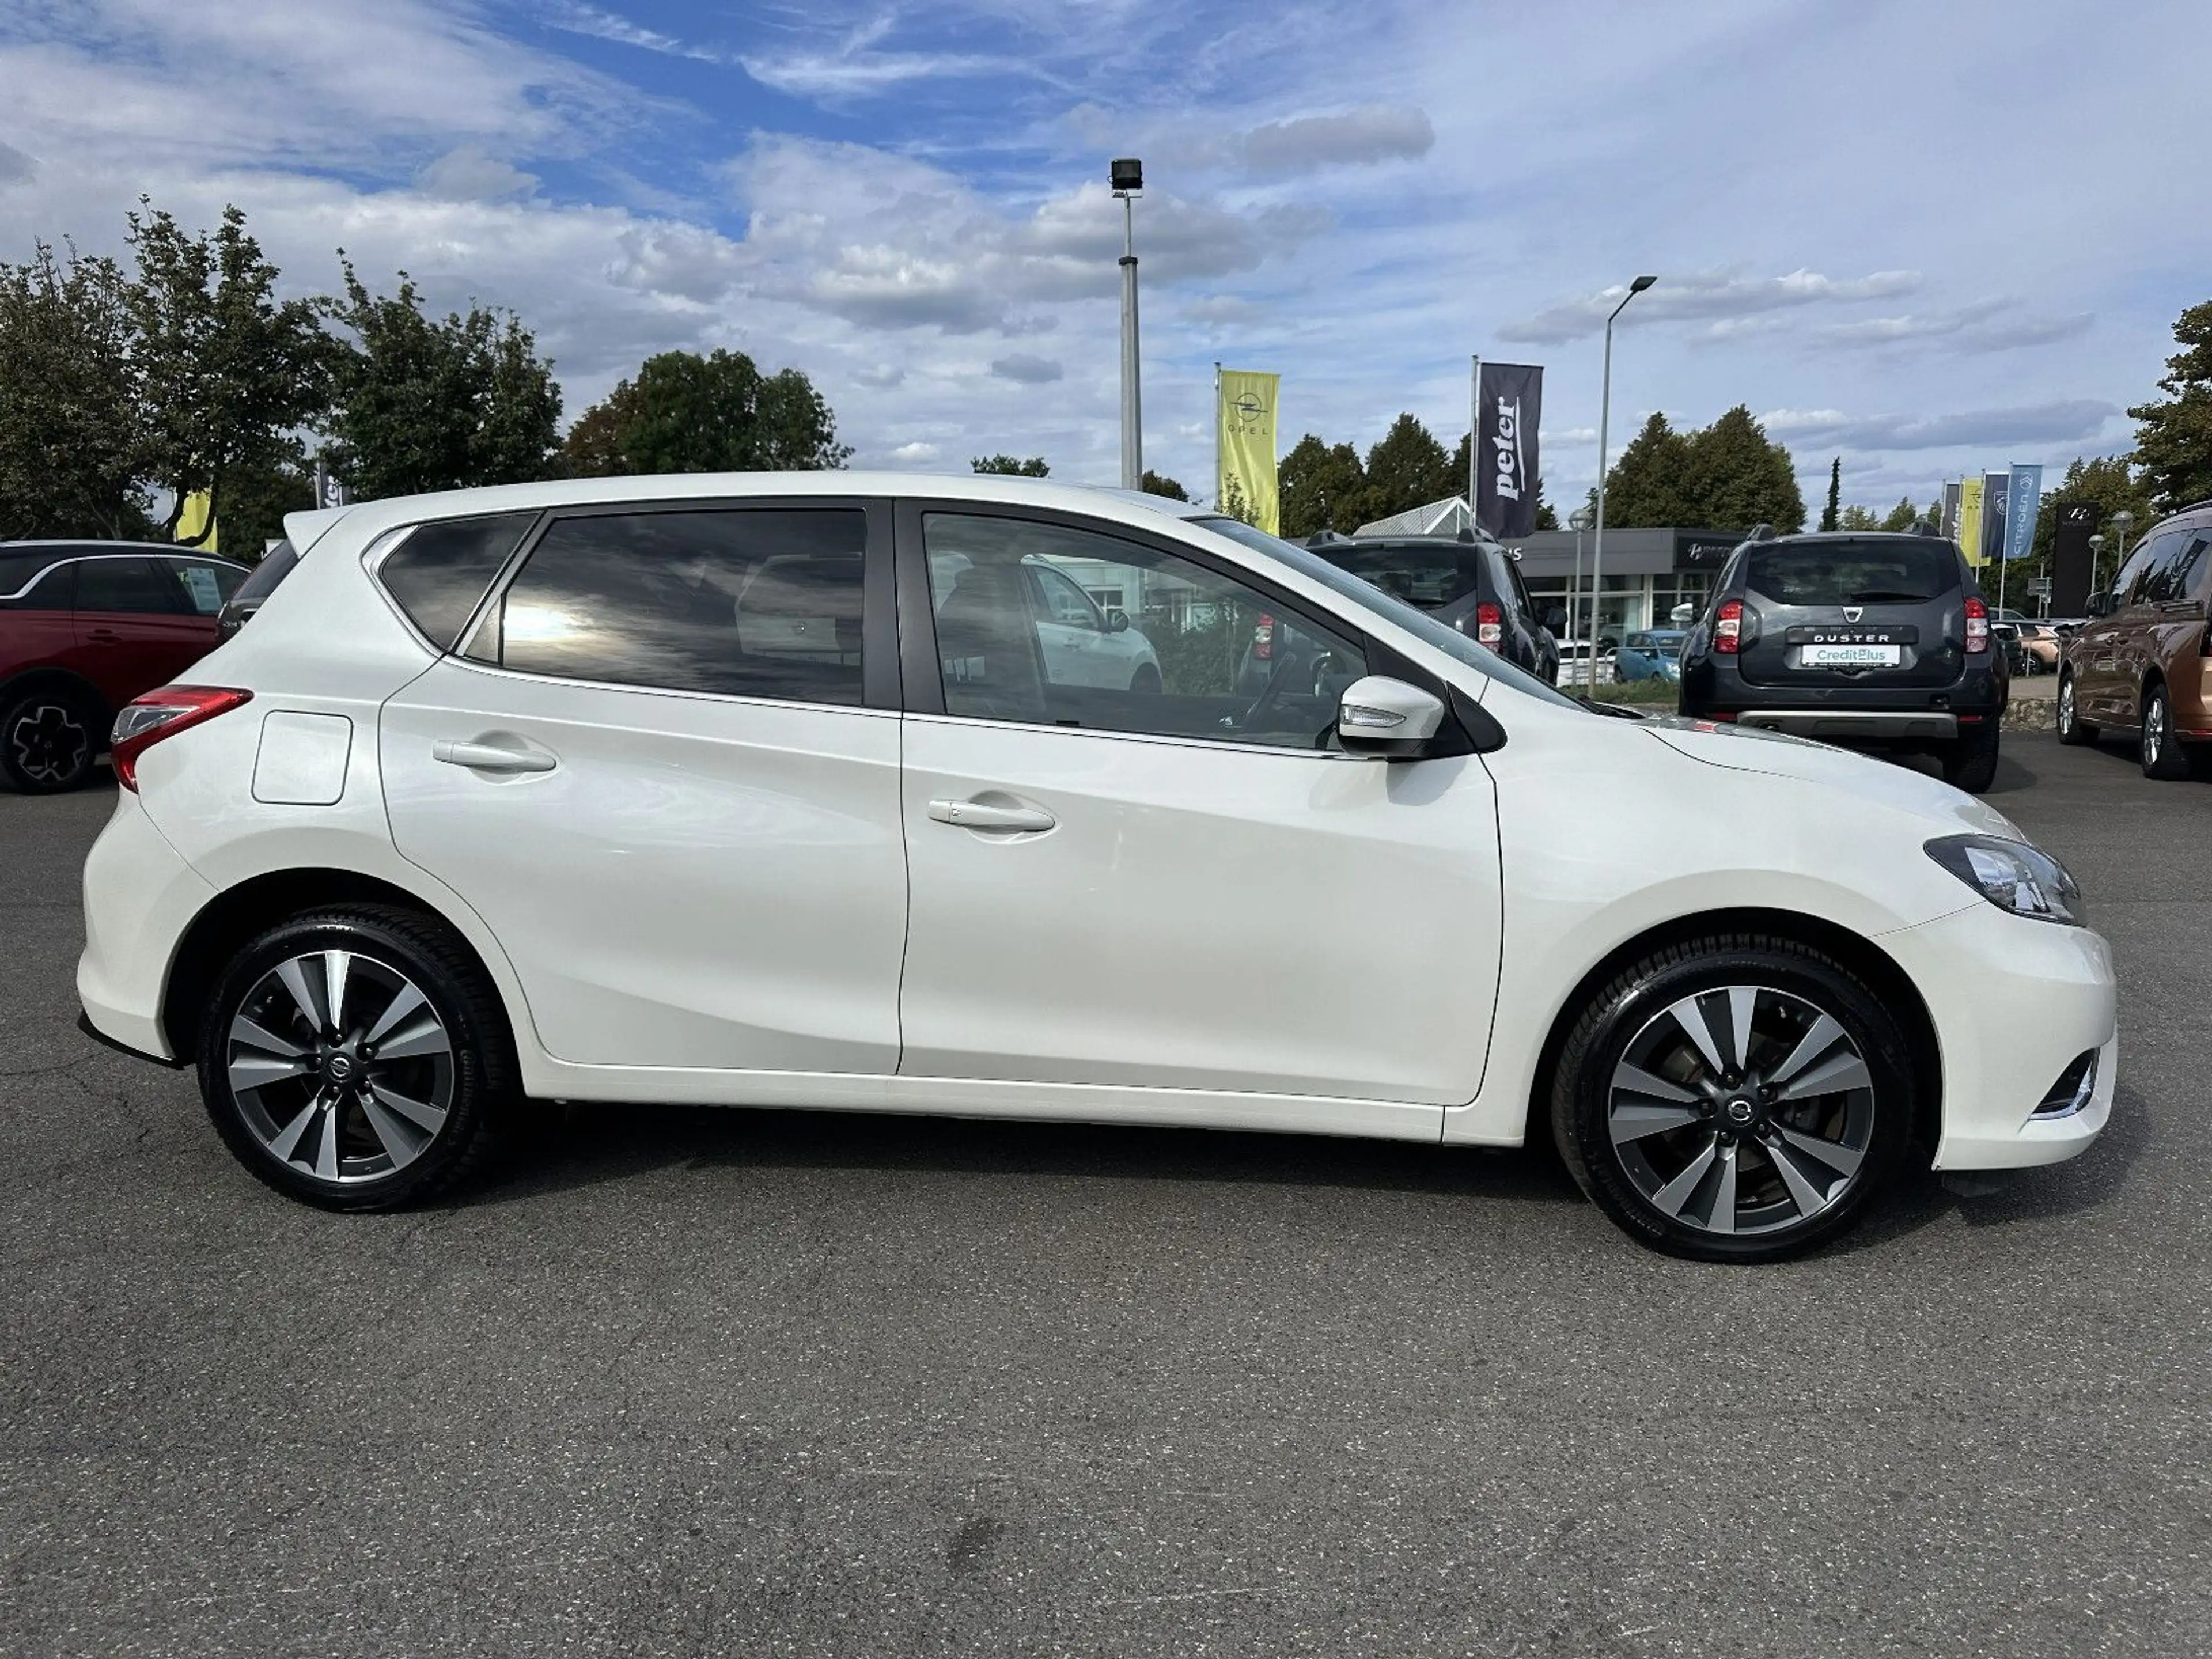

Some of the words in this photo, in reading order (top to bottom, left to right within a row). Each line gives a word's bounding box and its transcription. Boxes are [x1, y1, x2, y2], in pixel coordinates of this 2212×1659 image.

[1228, 424, 1268, 435] OPEL
[1493, 396, 1518, 501] peter
[1814, 635, 1890, 643] DUSTER
[1817, 648, 1886, 661] CreditPlus
